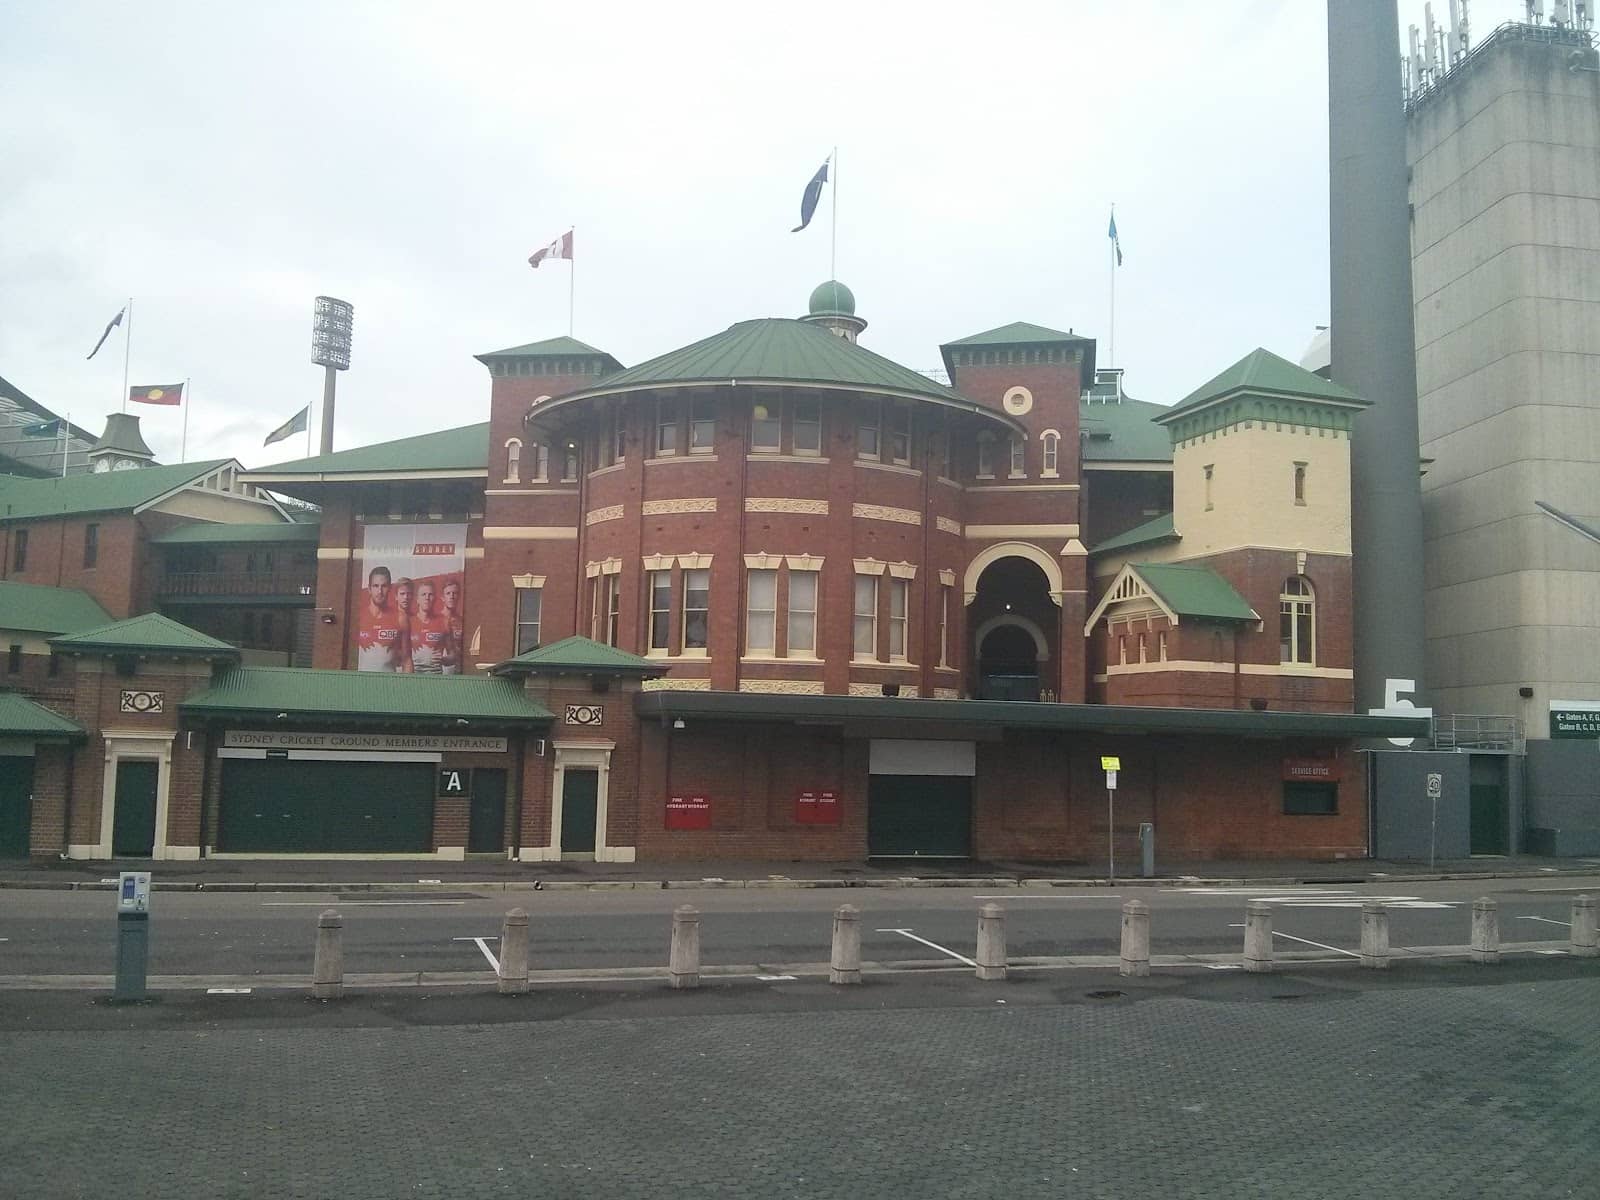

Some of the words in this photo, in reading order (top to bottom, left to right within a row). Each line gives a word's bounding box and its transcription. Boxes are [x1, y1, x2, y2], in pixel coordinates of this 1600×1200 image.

[231, 734, 273, 744] SYDNEY
[280, 735, 325, 745] CRICKET
[330, 736, 380, 747] GROUND
[443, 739, 502, 749] ENTRANCE
[447, 771, 461, 791] A
